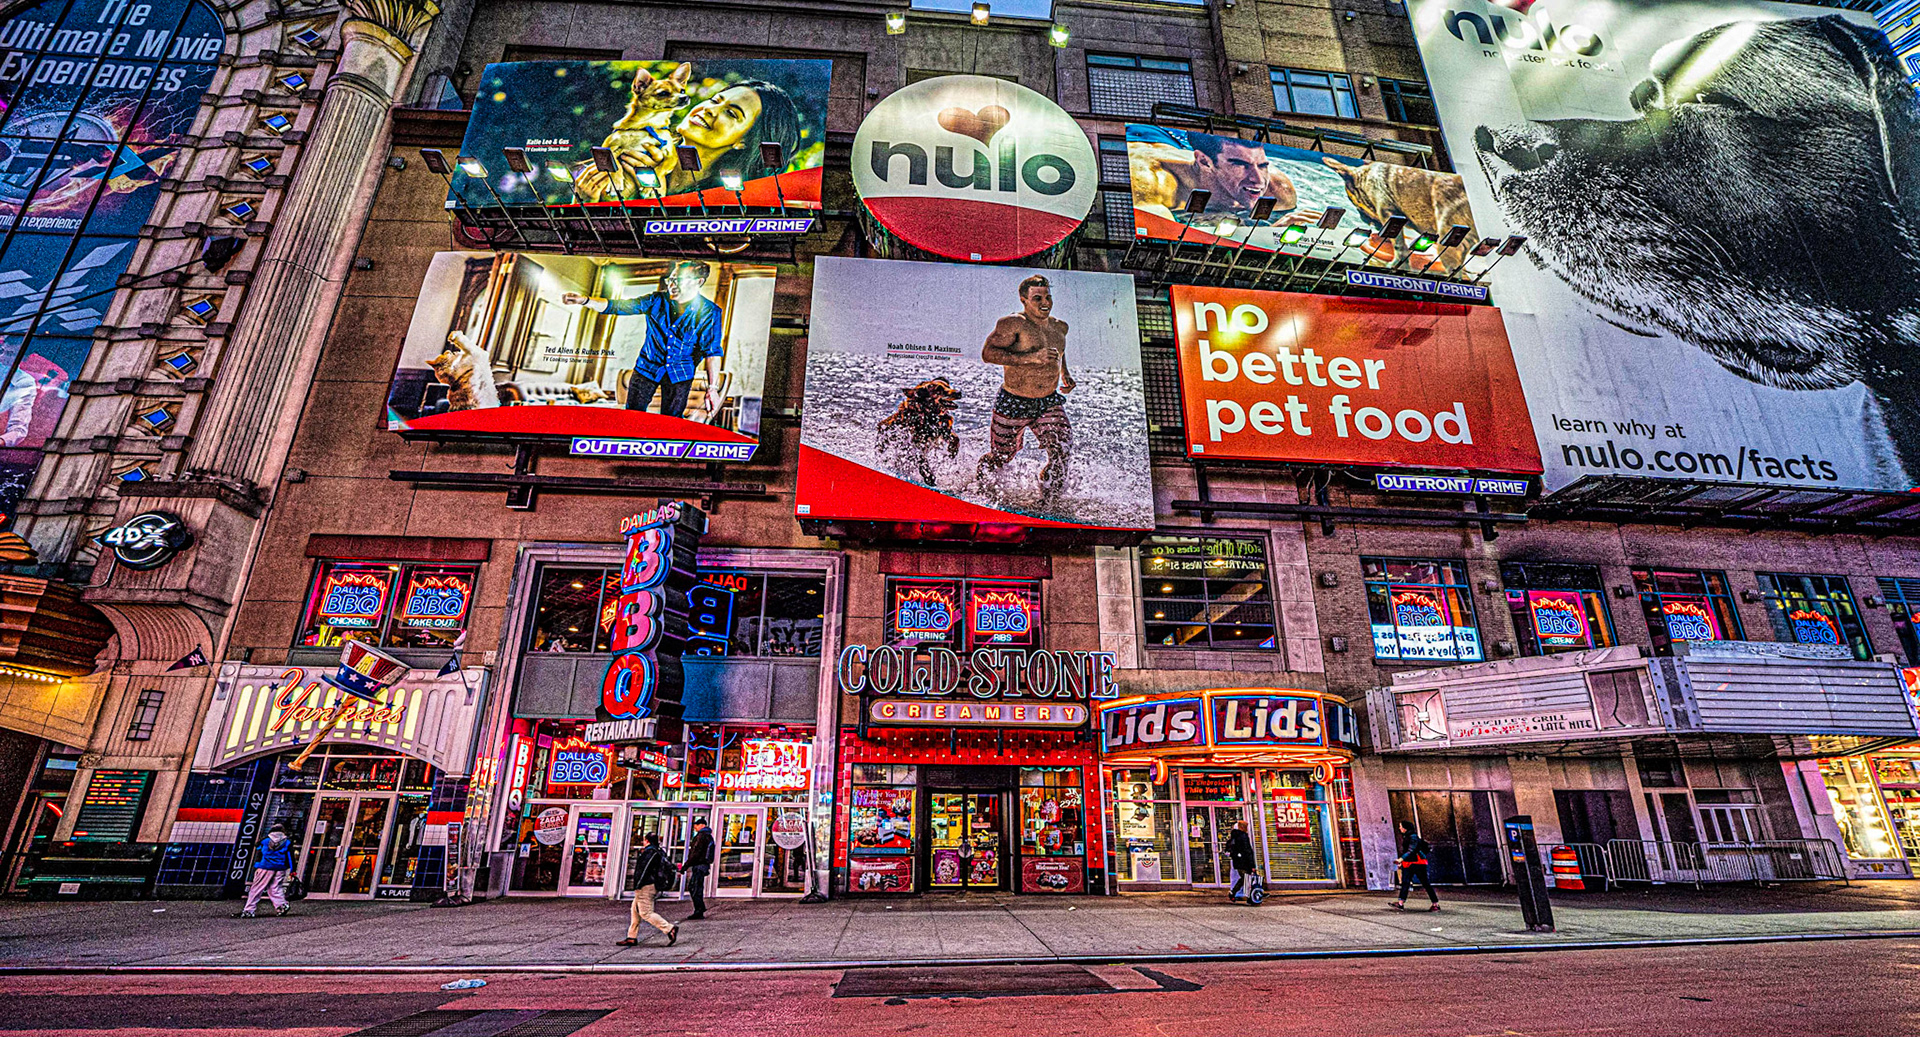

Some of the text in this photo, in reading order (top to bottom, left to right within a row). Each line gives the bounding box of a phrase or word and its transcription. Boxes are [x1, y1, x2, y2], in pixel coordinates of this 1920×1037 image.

[97, 0, 151, 26] The
[1, 19, 223, 61] Ultimate Movie
[1443, 7, 1604, 57] nulo
[0, 51, 187, 92] Experiences
[870, 136, 1076, 196] nulo
[28, 215, 82, 230] experience
[649, 219, 806, 233] OUTFRONT PRIME
[1351, 271, 1484, 298] OUTFRONT PRIME
[1193, 301, 1269, 335] no
[887, 342, 904, 350] Noah
[934, 345, 961, 353] Maximus
[1198, 339, 1387, 391] better
[1205, 394, 1474, 445] pet food
[1552, 413, 1686, 440] learn why at
[576, 440, 750, 460] OUTFRONT PRIME
[1561, 440, 1839, 482] nulo.com/facts
[1380, 475, 1525, 494] OUTFRONT PRIME
[619, 501, 677, 535] DALLAS
[105, 521, 177, 550] 4DX
[333, 586, 379, 596] DALLAS
[416, 587, 461, 598] DALLAS
[324, 593, 380, 615] BBQ
[407, 596, 463, 616] BBQ
[903, 601, 945, 611] DALLAS
[981, 603, 1023, 613] DALLAS
[1400, 604, 1437, 613] DALLAS
[1538, 608, 1573, 617] DALLAS
[328, 617, 368, 626] CHICKEN
[408, 618, 455, 628] TAKE OUT
[602, 526, 672, 720] BBQ
[899, 609, 951, 630] BBQ
[977, 611, 1028, 632] BBQ
[1538, 616, 1582, 635] BBQ
[1670, 614, 1705, 623] DALLAS
[1795, 620, 1828, 629] DALLAS
[903, 631, 946, 641] CATERING
[993, 633, 1012, 642] RIBS
[1669, 622, 1712, 640] BBQ
[1796, 627, 1838, 644] BBQ
[839, 644, 1119, 699] COLD STONE
[881, 703, 1076, 720] CREAMERY
[1224, 699, 1322, 739] Lids
[1532, 714, 1568, 723] GRILL
[585, 718, 652, 743] RESTAURANT
[1106, 703, 1197, 747] Lids
[558, 752, 604, 762] DALLAS
[508, 743, 529, 811] BBQ
[550, 761, 608, 783] BBQ
[540, 815, 565, 824] ZAGAT
[1277, 808, 1306, 823] 50%
[230, 792, 264, 880] SECTION 42
